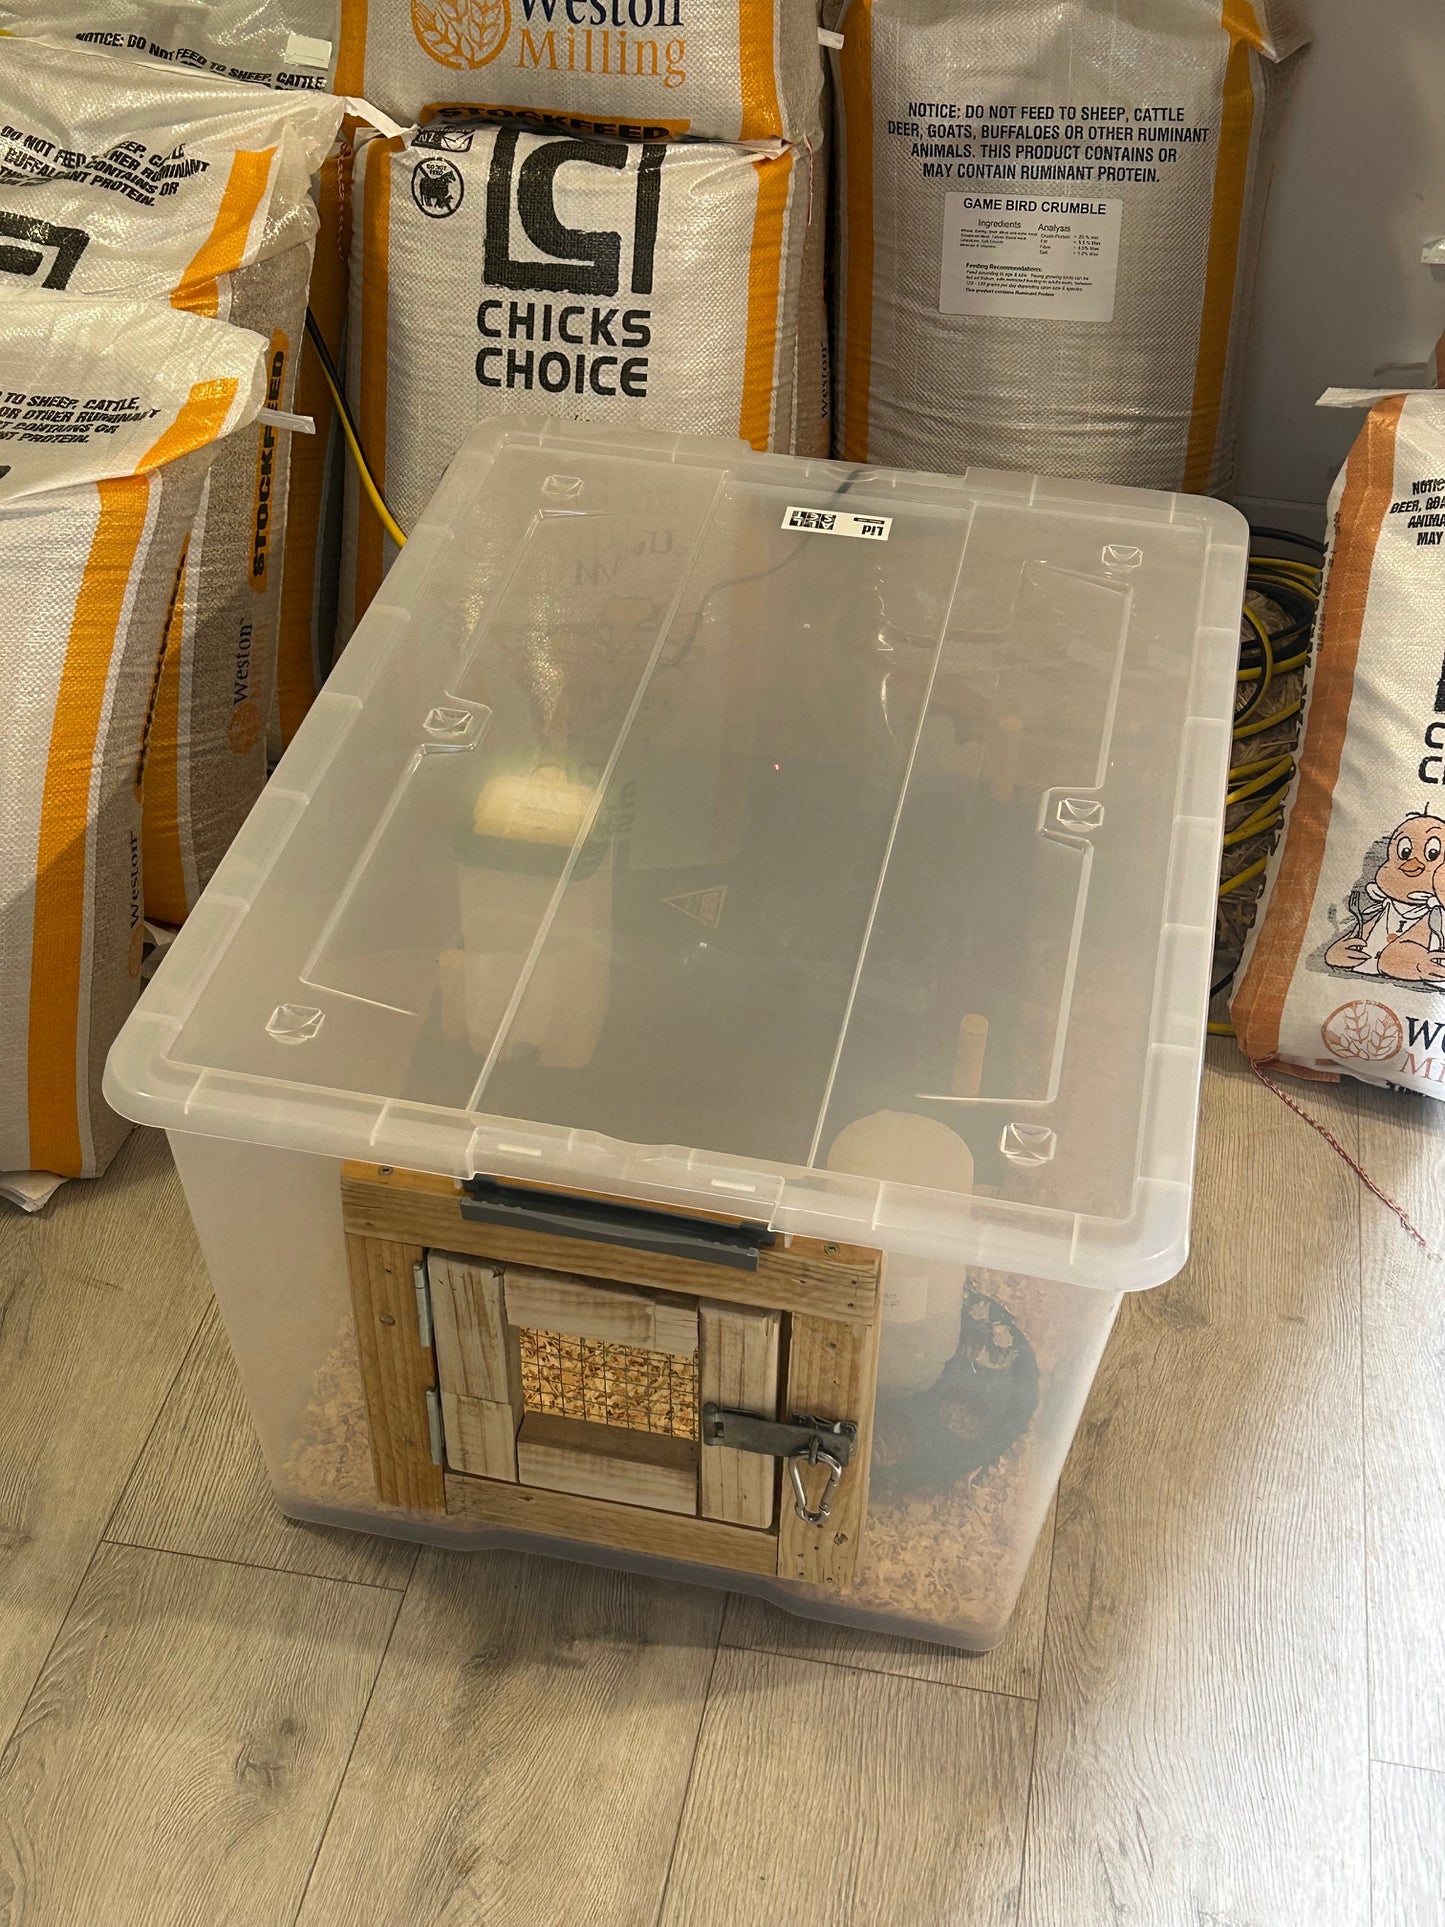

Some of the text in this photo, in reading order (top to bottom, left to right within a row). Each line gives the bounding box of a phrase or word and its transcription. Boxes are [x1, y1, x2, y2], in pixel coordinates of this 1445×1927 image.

[522, 0, 684, 27] Weston
[127, 35, 147, 50] DO
[149, 43, 175, 61] NOT
[175, 48, 207, 66] FEED
[210, 61, 227, 73] TO
[513, 26, 687, 88] Milling
[908, 102, 1184, 122] NOTICE: DO NOT FEED TO SHEEP, CATTLE
[438, 107, 670, 140] STOCKFEED
[888, 120, 1209, 142] DEER, GOATS, BUFFALOES OR OTHER RUMINANT
[0, 125, 24, 141] DO
[23, 135, 57, 157] NOT
[911, 143, 1177, 163] ANIMALS. THIS PRODUCT CONTAINS OR
[85, 160, 159, 194] CONTAINS
[159, 181, 180, 197] OR
[922, 162, 1160, 183] MAY CONTAIN RUMINANT PROTEIN.
[89, 174, 156, 207] PROTEIN.
[963, 197, 1107, 215] GAME BIRD CRUMBLE
[978, 219, 1021, 228] Ingredients
[1038, 223, 1071, 233] Analysis
[476, 300, 652, 349] CHICKS
[475, 346, 649, 398] CHOICE
[3, 392, 26, 405] TO
[83, 396, 140, 412] CATTLE,
[0, 406, 22, 419] OR
[22, 409, 74, 423] OTHER
[94, 424, 120, 434] OR
[1412, 478, 1445, 495] NOTIC
[861, 524, 884, 537] Lid
[1407, 513, 1445, 528] ANIMA
[1417, 531, 1443, 545] MAY
